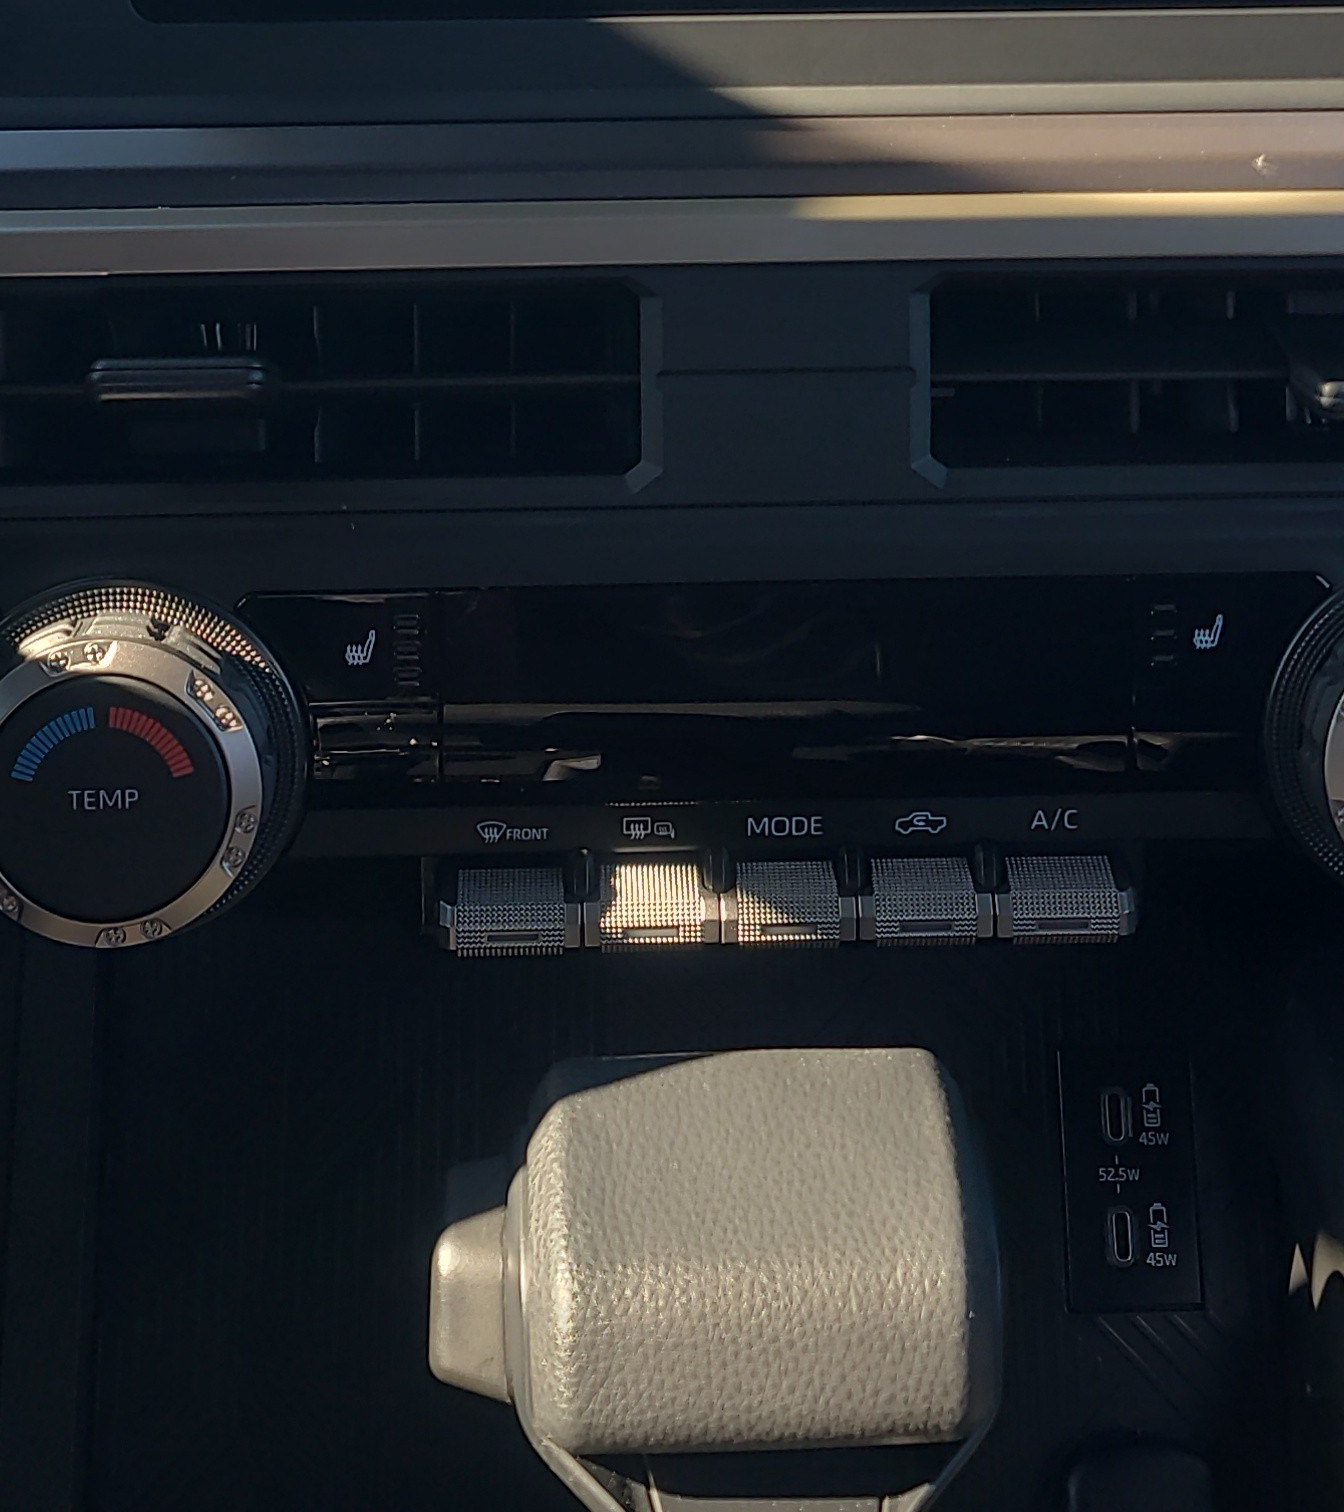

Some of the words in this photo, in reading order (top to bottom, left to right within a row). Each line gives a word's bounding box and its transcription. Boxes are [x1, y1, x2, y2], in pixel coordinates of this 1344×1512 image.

[68, 789, 140, 810] TEMP
[746, 815, 824, 837] MODE
[1030, 808, 1079, 832] A/C
[505, 827, 549, 841] FRONT
[1139, 1132, 1169, 1146] 45W
[1099, 1168, 1140, 1181] 52.5W
[1146, 1253, 1178, 1267] 45W
